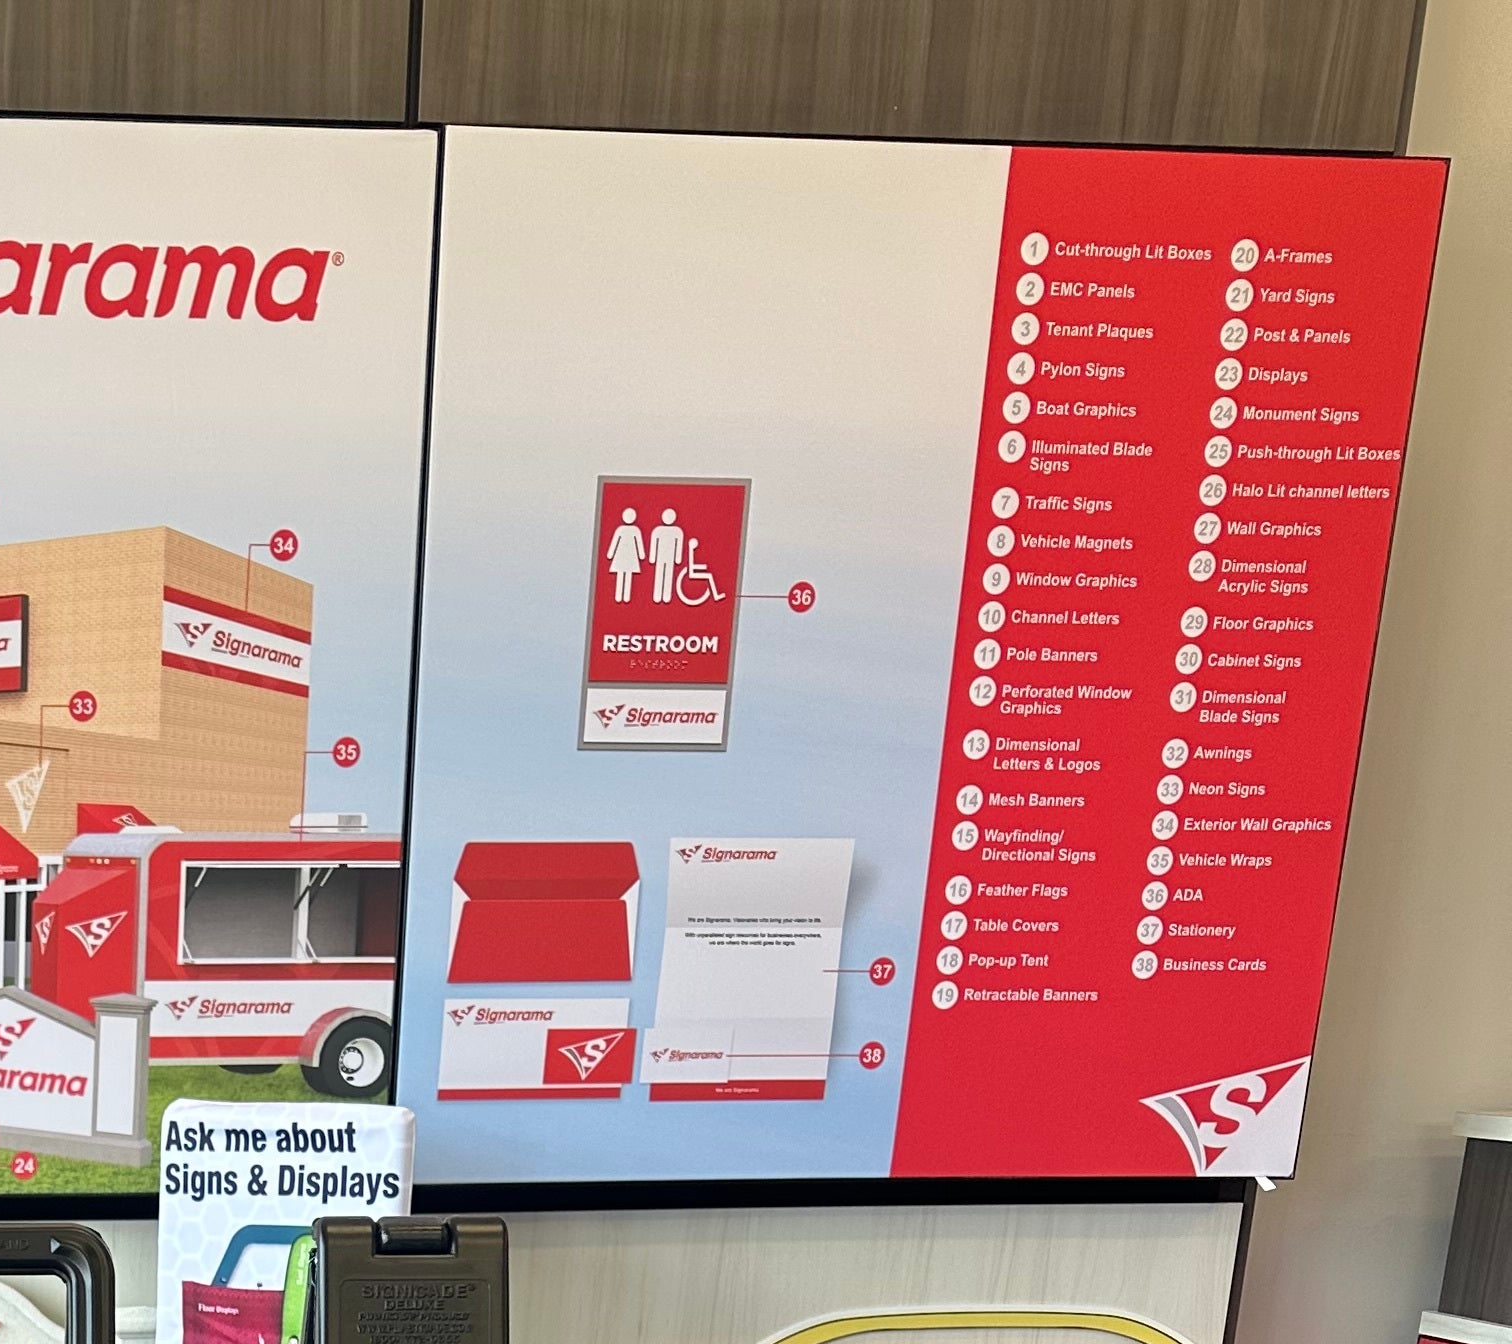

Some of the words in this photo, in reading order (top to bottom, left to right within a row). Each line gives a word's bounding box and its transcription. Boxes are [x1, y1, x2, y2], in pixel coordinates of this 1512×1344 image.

[1054, 241, 1142, 262] Cut-through
[1144, 244, 1165, 260] Lit
[1166, 244, 1212, 261] Boxes
[1263, 247, 1333, 264] A-Frames
[1049, 281, 1084, 297] EMC
[1087, 282, 1136, 299] Panels
[1260, 287, 1293, 303] Yard
[1294, 288, 1335, 308] Signs
[1045, 321, 1094, 338] Tenant
[1096, 322, 1154, 342] Plaques
[1253, 326, 1287, 343] Post
[1288, 327, 1300, 343] &
[1303, 328, 1351, 344] Panels
[1040, 360, 1082, 380] Pylon
[1084, 362, 1126, 381] Signs
[1247, 366, 1308, 386] Displays
[1035, 400, 1070, 416] Boat
[1072, 401, 1137, 420] Graphics
[1242, 405, 1318, 422] Monument
[1319, 407, 1360, 426] Signs
[1031, 439, 1110, 456] Illuminated
[1112, 441, 1153, 457] Blade
[1237, 444, 1333, 464] Push-through
[1335, 446, 1355, 461] Lit
[1357, 446, 1402, 461] Boxes
[1029, 456, 1070, 475] Signs
[1231, 482, 1264, 498] Halo
[1267, 483, 1286, 498] Lit
[1288, 483, 1345, 499] channel
[1346, 484, 1390, 499] letters
[1025, 495, 1070, 511] Traffic
[1072, 496, 1113, 515] Signs
[1227, 520, 1257, 536] Wall
[1259, 521, 1322, 539] Graphics
[1020, 533, 1071, 549] Vehicle
[1074, 534, 1133, 553] Magnets
[1220, 558, 1307, 574] Dimensional
[1015, 571, 1073, 587] Window
[1074, 572, 1138, 591] Graphics
[1217, 578, 1267, 597] Acrylic
[1269, 579, 1309, 597] Signs
[791, 589, 812, 606] 36
[1011, 609, 1069, 625] Channel
[1071, 610, 1120, 625] Letters
[1212, 615, 1250, 630] Floor
[1252, 616, 1314, 634] Graphics
[211, 630, 303, 669] Signarama
[602, 635, 719, 655] RESTROOM
[1006, 646, 1038, 662] Pole
[1040, 647, 1098, 663] Banners
[1207, 652, 1261, 668] Cabinet
[1262, 653, 1302, 671] Signs
[1001, 683, 1075, 699] Perforated
[1077, 685, 1133, 700] Window
[1201, 689, 1287, 705] Dimensional
[624, 706, 718, 726] Signarama
[999, 700, 1062, 718] Graphics
[1198, 709, 1238, 723] Blade
[1241, 709, 1280, 727] Signs
[995, 736, 1081, 752] Dimensional
[1192, 745, 1253, 763] Awnings
[992, 756, 1041, 771] Letters
[1043, 756, 1055, 771] &
[1058, 757, 1101, 775] Logos
[1188, 781, 1224, 796] Neon
[1227, 781, 1266, 799] Signs
[988, 792, 1025, 807] Mesh
[1028, 792, 1085, 808] Banners
[1183, 817, 1238, 832] Exterior
[1240, 817, 1269, 832] Wall
[1271, 817, 1332, 834] Graphics
[701, 846, 777, 863] Signarama
[981, 847, 1055, 862] Directional
[1057, 848, 1097, 865] Signs
[1178, 852, 1227, 867] Vehicle
[1230, 853, 1273, 870] Wraps
[977, 882, 1030, 897] Feather
[1031, 883, 1069, 900] Flags
[1172, 888, 1204, 902] ADA
[973, 918, 1009, 932] Table
[1011, 918, 1060, 932] Covers
[1167, 923, 1237, 940] Stationery
[968, 953, 1017, 970] Pop-up
[1020, 953, 1049, 967] Tent
[1162, 957, 1225, 971] Business
[1227, 957, 1267, 971] Cards
[963, 987, 1040, 1002] Retractable
[1042, 988, 1099, 1002] Banners
[197, 999, 294, 1018] Signarama
[474, 1006, 554, 1024] Signarama
[165, 1121, 215, 1151] Ask
[225, 1128, 267, 1152] me
[276, 1121, 356, 1152] about
[165, 1163, 238, 1202] Signs
[247, 1164, 268, 1196] &
[278, 1164, 400, 1204] Displays
